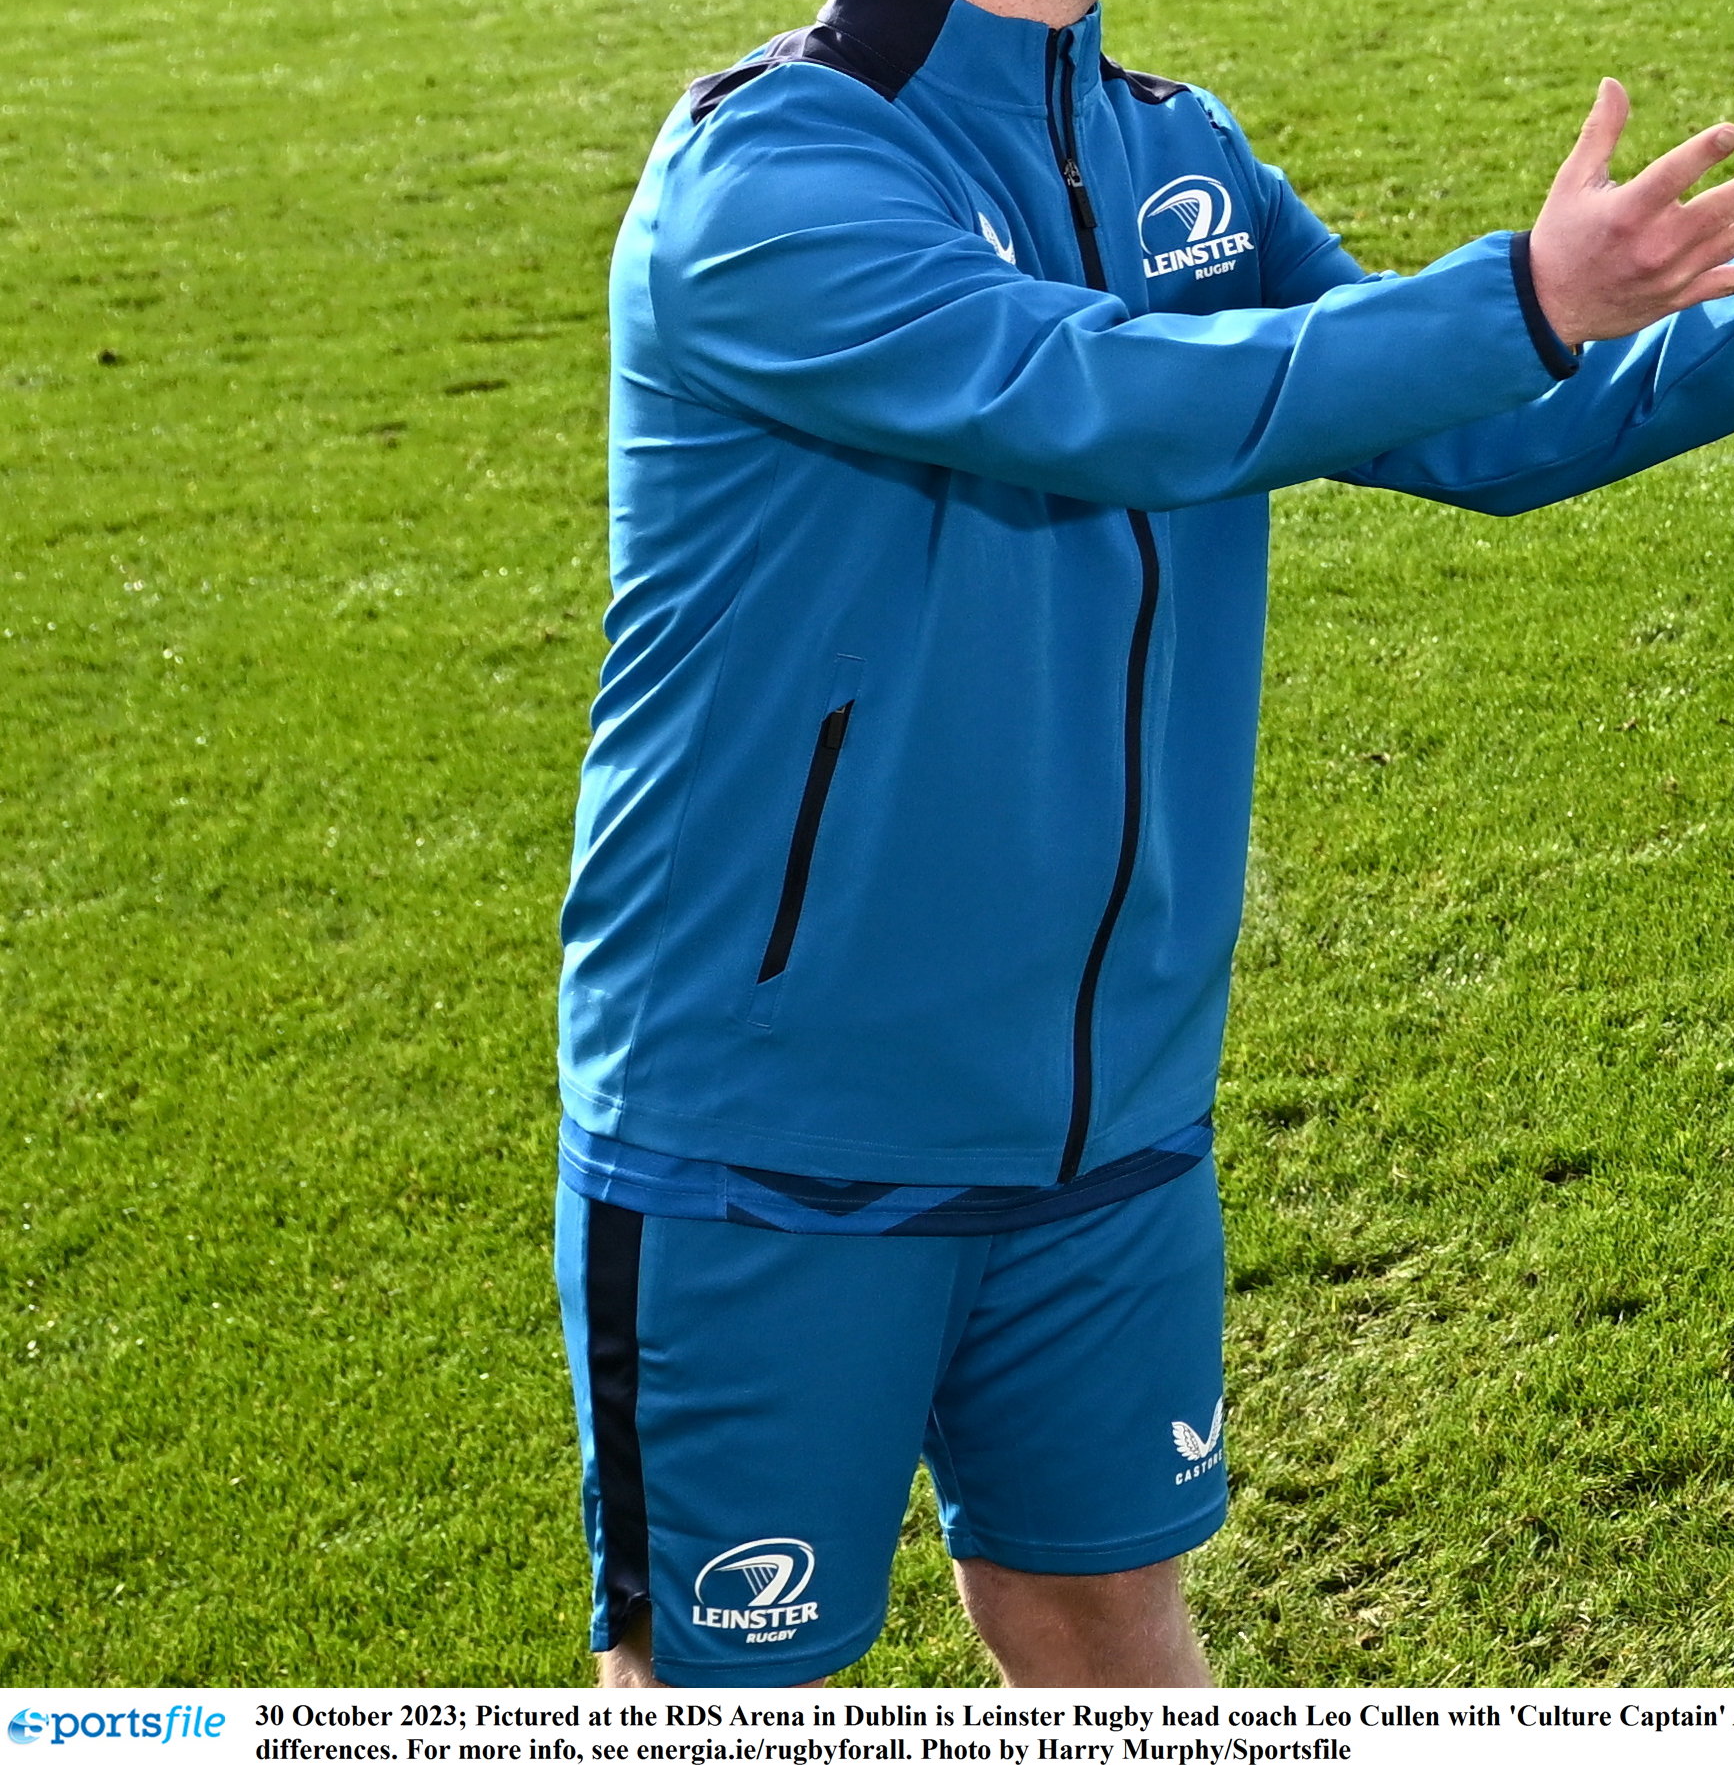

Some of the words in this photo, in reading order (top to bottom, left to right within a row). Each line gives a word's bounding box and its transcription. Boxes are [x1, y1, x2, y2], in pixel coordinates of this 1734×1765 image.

[1143, 232, 1254, 278] LEINSTER
[1195, 260, 1236, 280] RUGBY
[1175, 1448, 1223, 1486] CASTORE
[693, 1601, 819, 1629] LEINSTER
[746, 1628, 797, 1643] RUGBY
